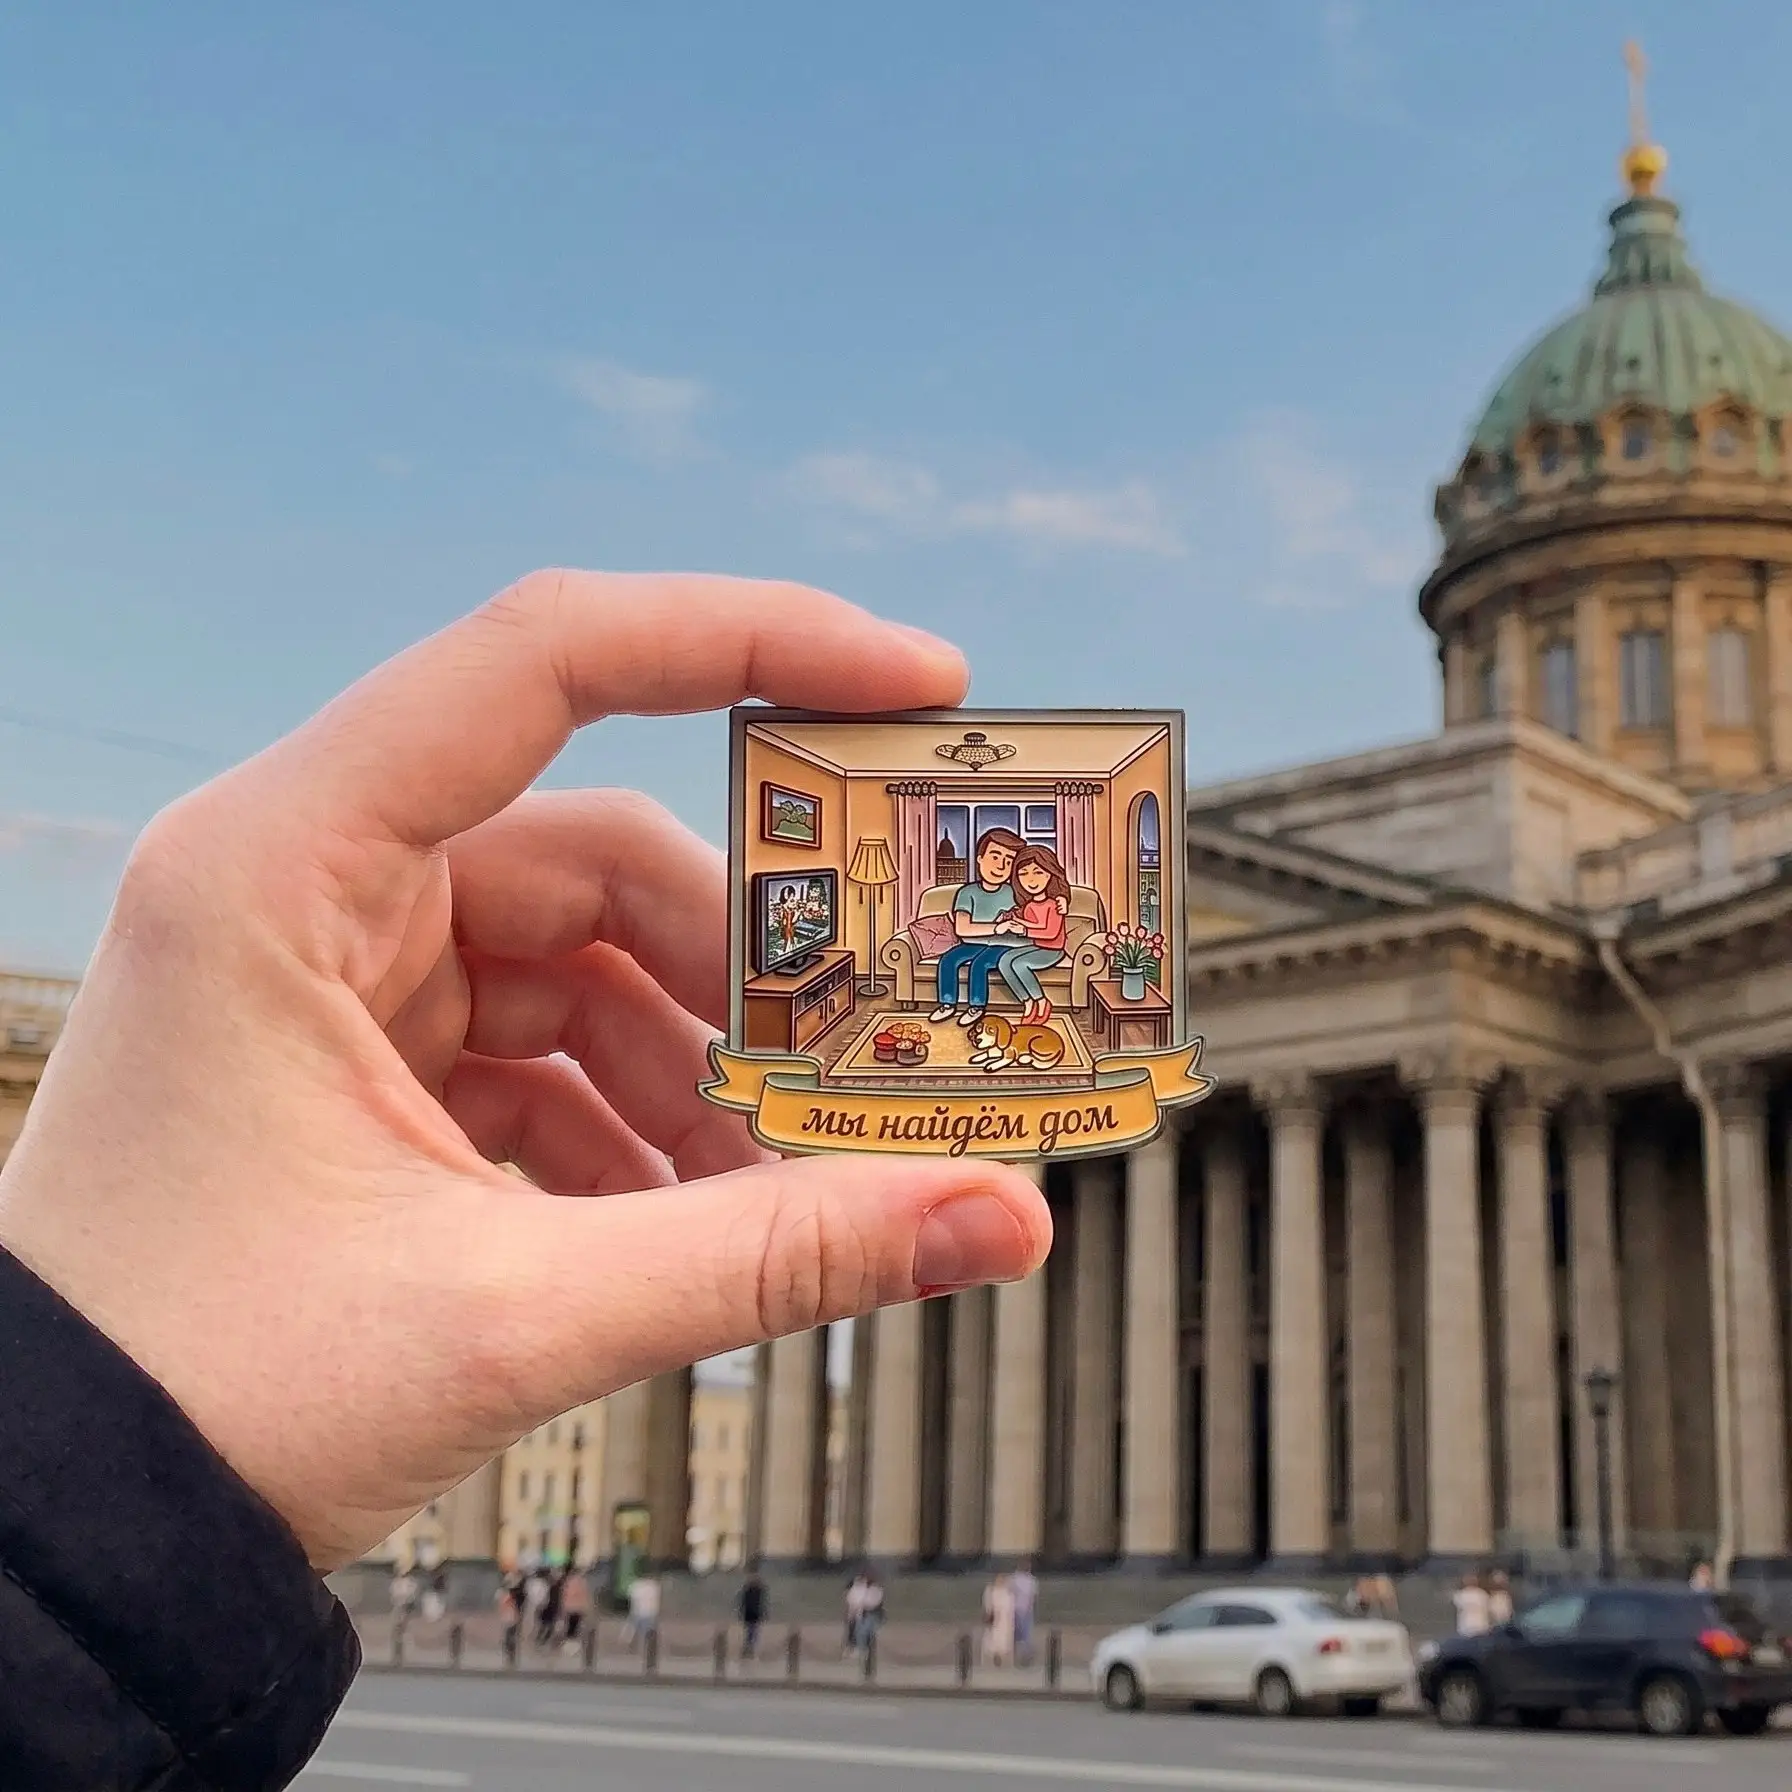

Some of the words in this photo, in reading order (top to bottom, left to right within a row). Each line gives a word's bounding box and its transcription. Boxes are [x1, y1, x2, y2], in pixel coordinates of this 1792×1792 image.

[801, 1105, 867, 1138] мы
[878, 1106, 1028, 1158] найдём
[1038, 1104, 1119, 1152] дом
